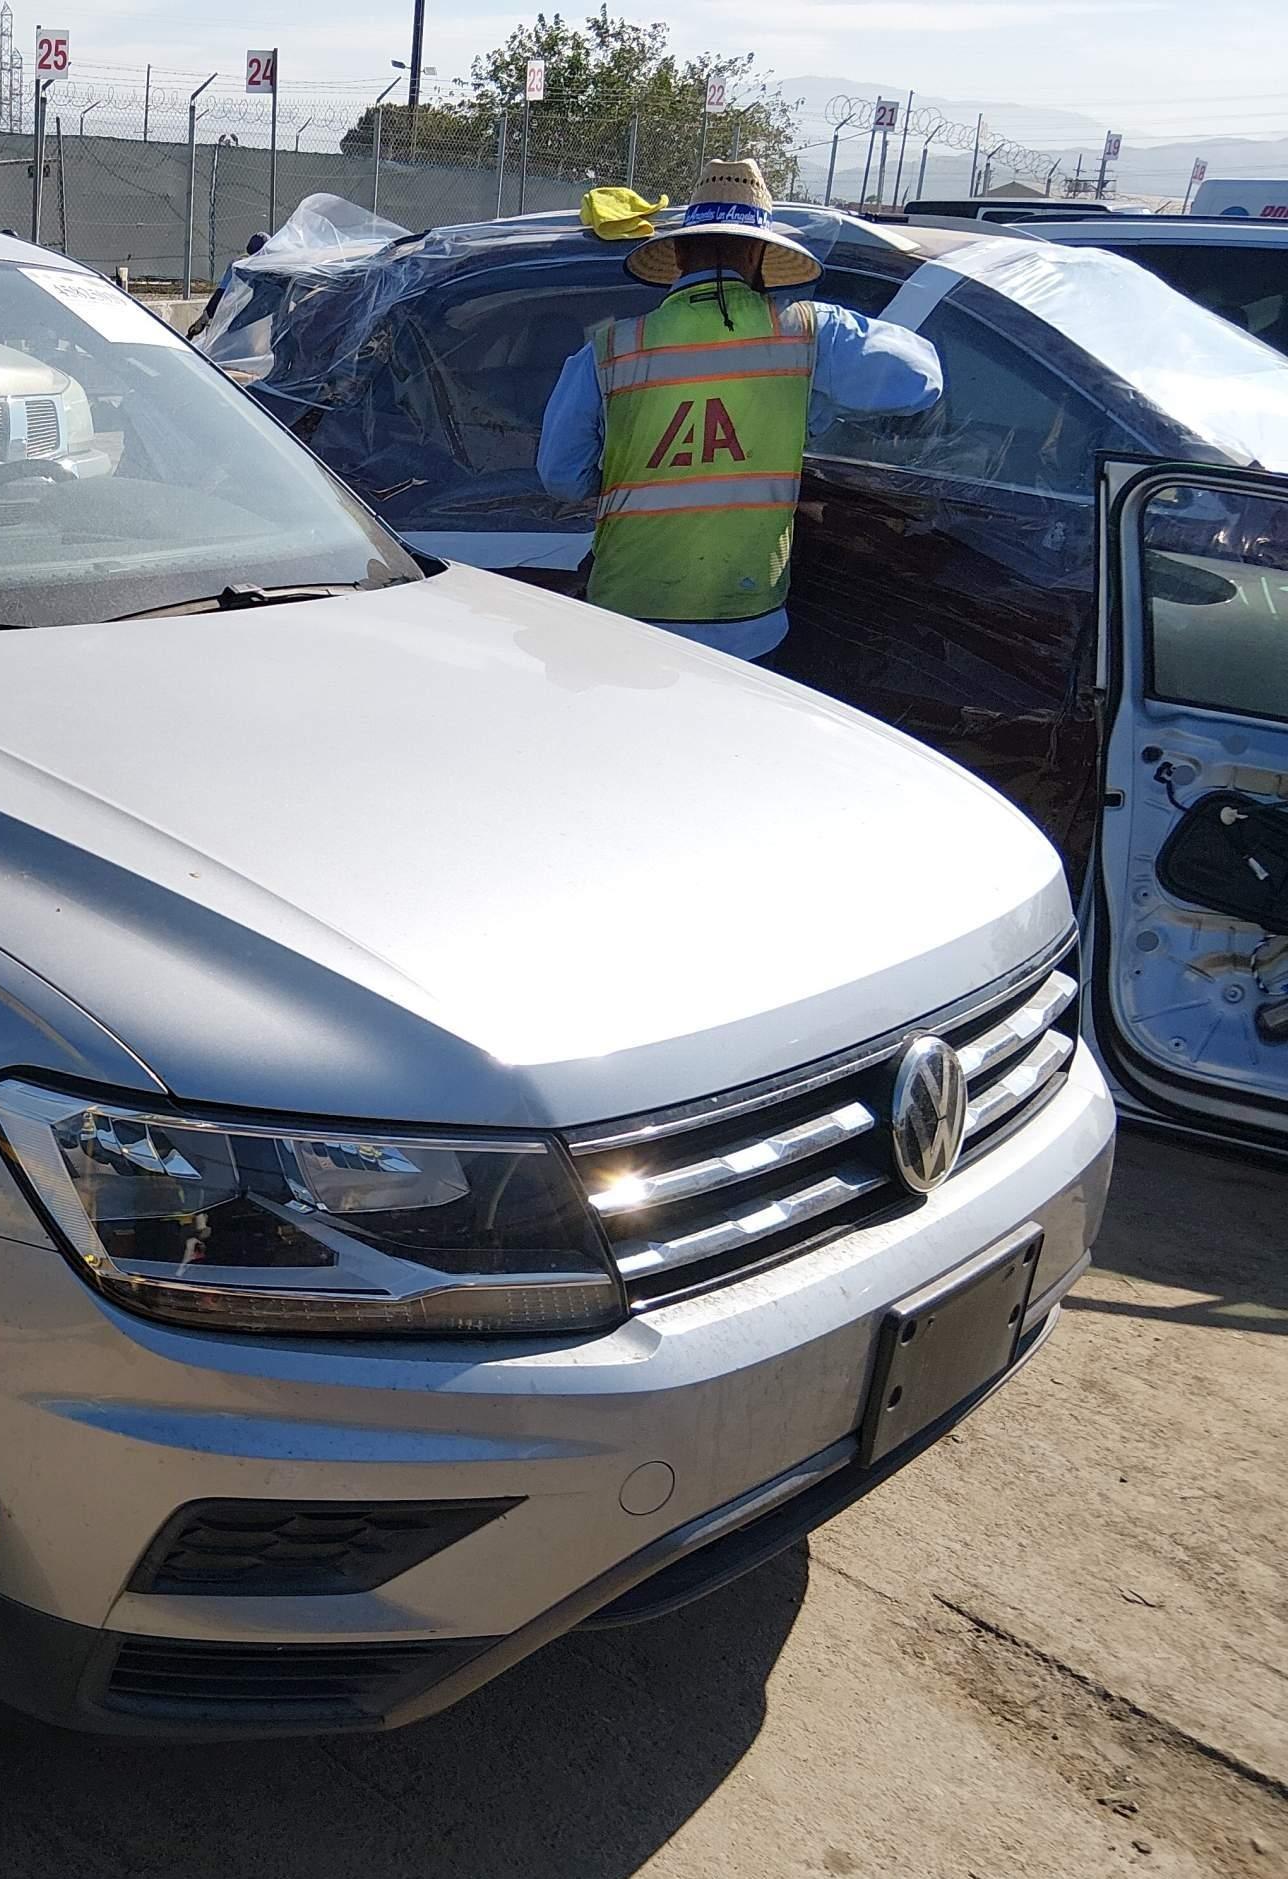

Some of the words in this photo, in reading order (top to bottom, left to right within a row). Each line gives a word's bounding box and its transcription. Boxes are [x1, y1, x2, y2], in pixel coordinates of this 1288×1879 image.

[38, 38, 67, 70] 25
[248, 57, 274, 86] 24
[528, 68, 543, 92] 23
[708, 84, 725, 106] 22
[875, 106, 895, 126] 21
[1106, 139, 1121, 156] 19
[1193, 166, 1207, 181] 18
[725, 204, 755, 224] Angeles
